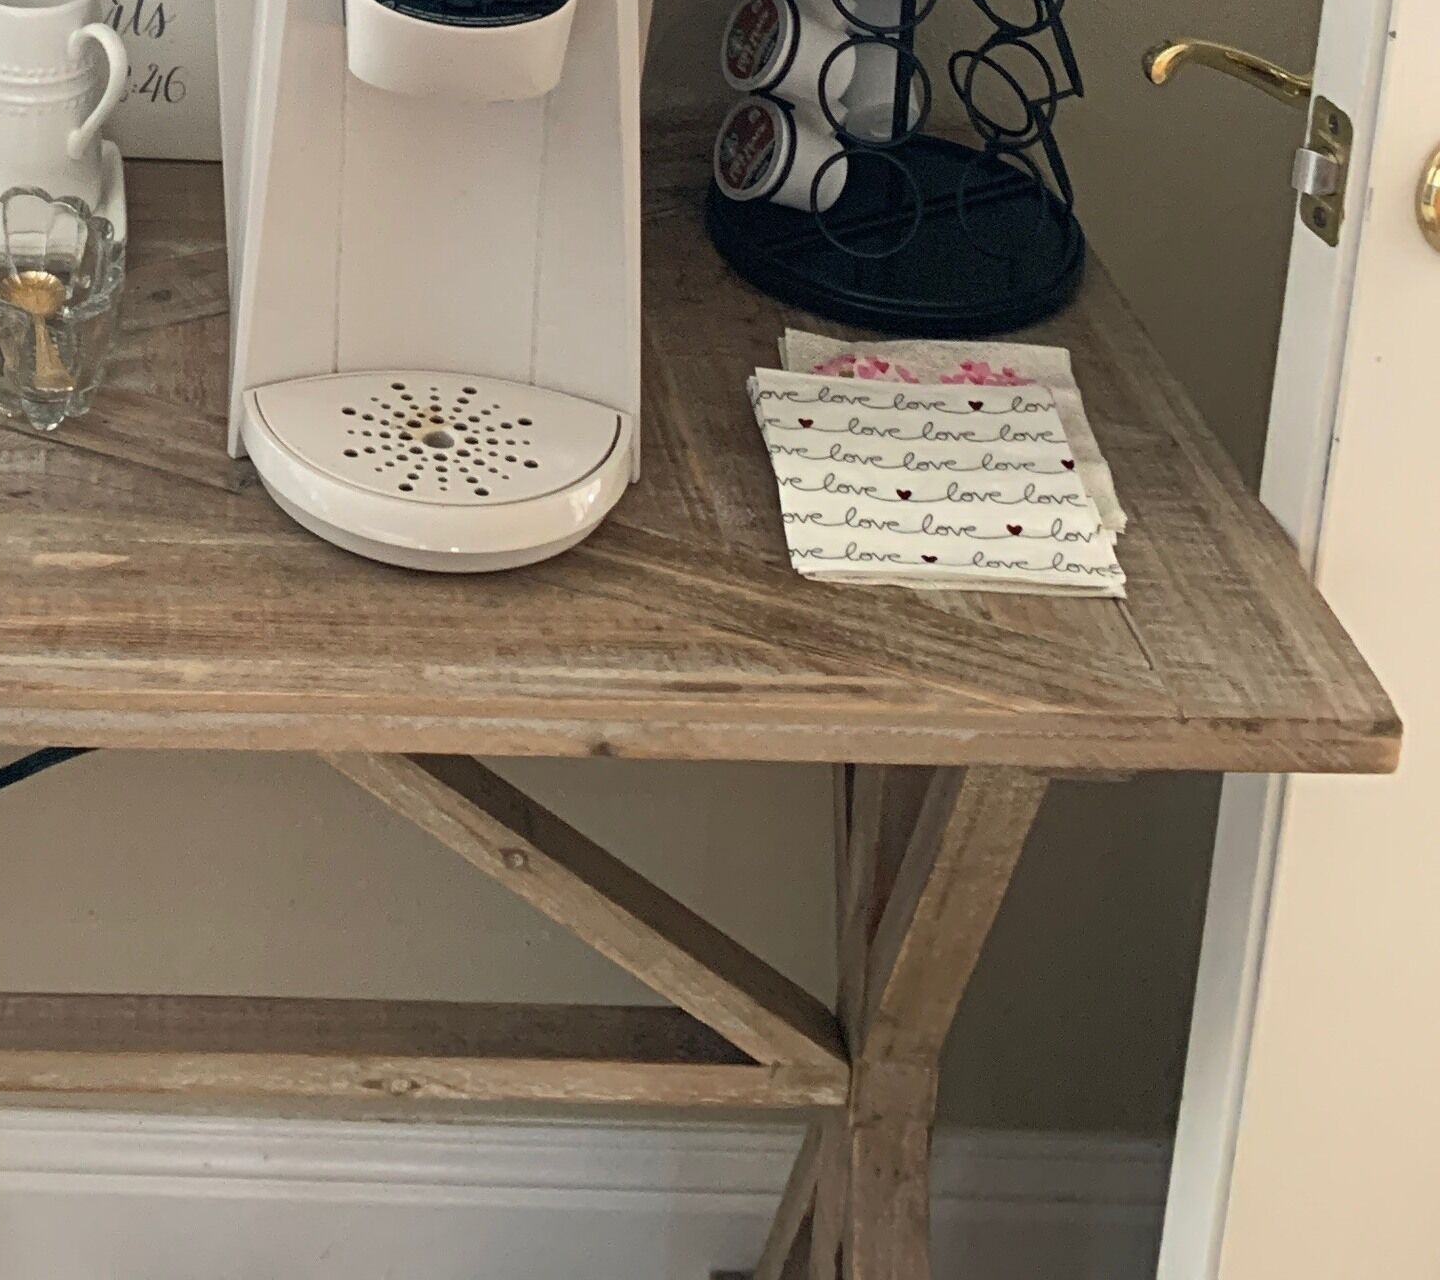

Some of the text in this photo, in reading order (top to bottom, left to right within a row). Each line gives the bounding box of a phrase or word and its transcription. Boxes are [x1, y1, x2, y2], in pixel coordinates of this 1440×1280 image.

[759, 386, 1056, 414] ove love love lov
[848, 417, 1055, 443] love love love
[769, 443, 1036, 473] ove love love love
[823, 472, 878, 496] love
[946, 481, 1002, 503] love
[1023, 483, 1081, 506] love
[782, 506, 1093, 543] ove love love lov
[845, 541, 902, 564] love
[972, 551, 1030, 571] love
